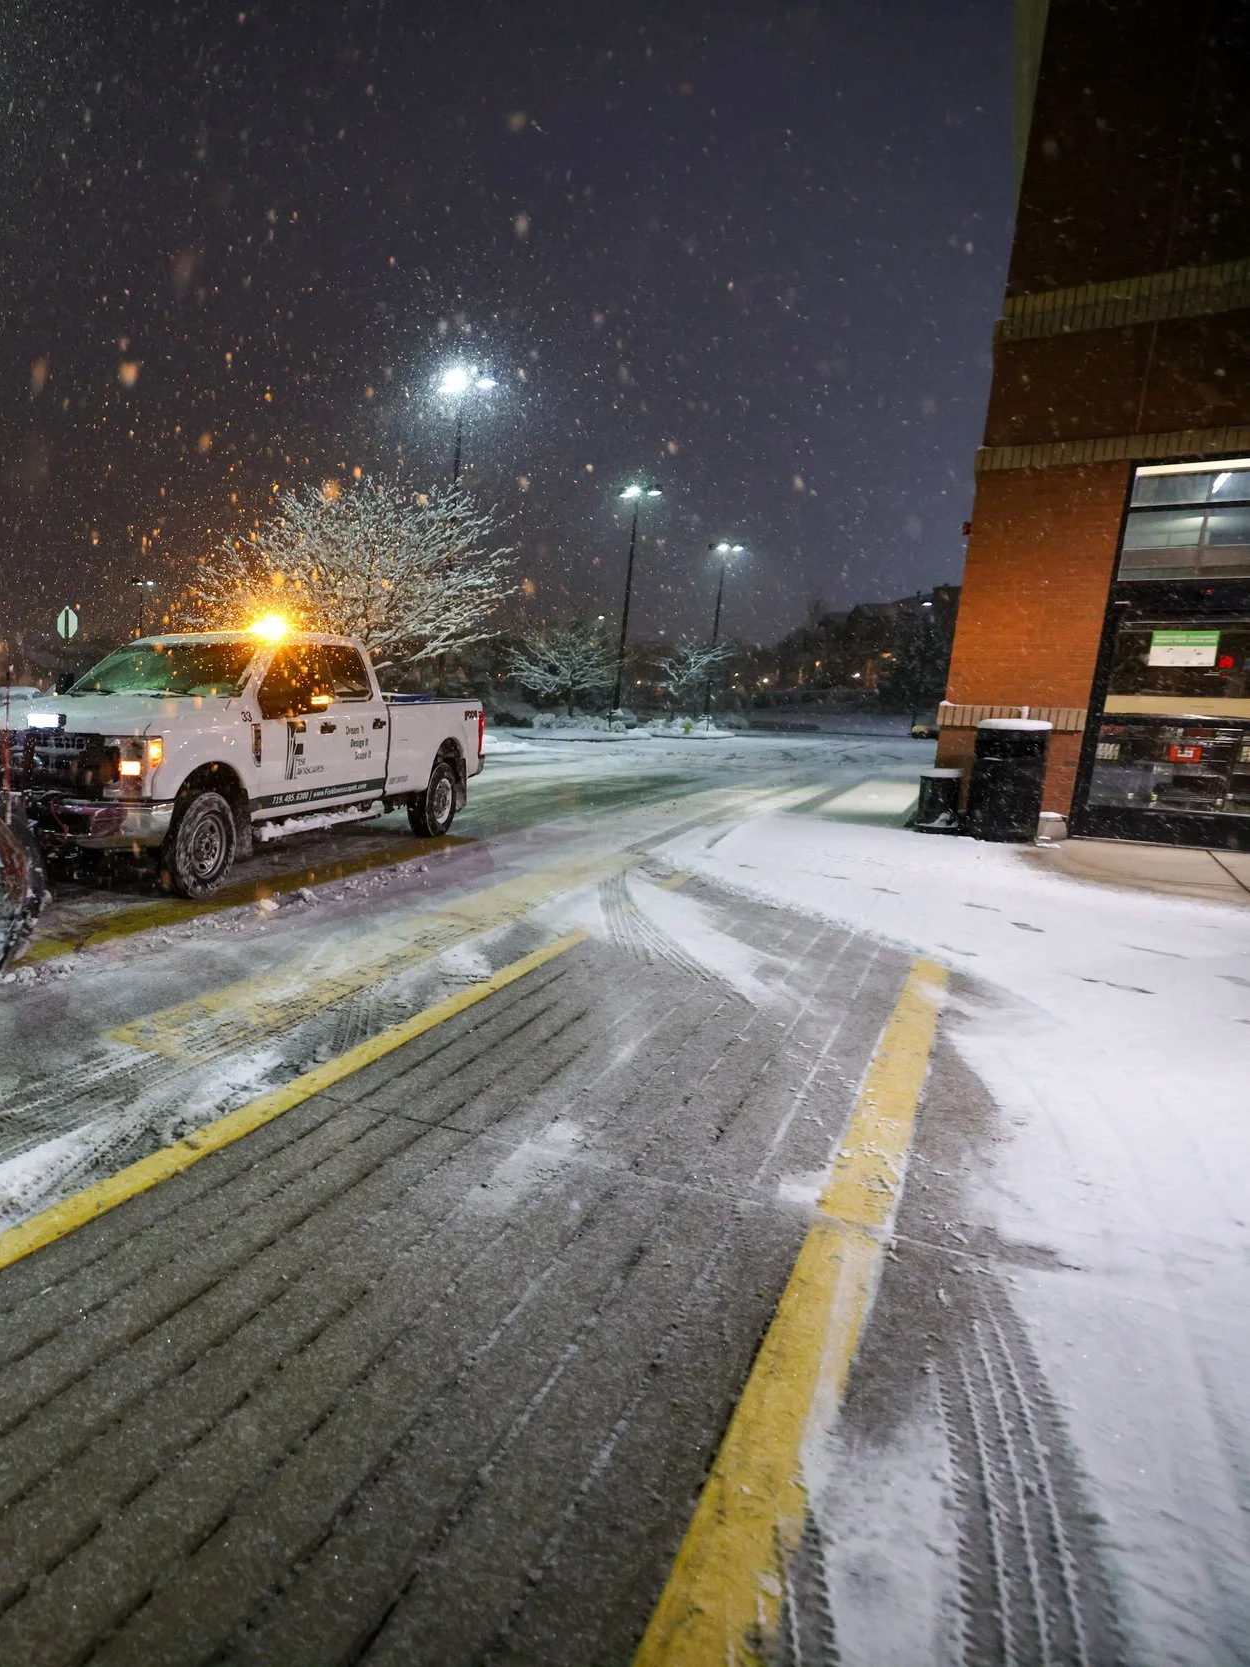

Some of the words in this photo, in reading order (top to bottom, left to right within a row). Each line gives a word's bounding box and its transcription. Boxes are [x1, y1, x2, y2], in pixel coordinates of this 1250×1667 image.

[241, 711, 252, 722] 33
[346, 725, 360, 735] Dream
[350, 738, 364, 749] Design
[355, 751, 367, 761] Scape
